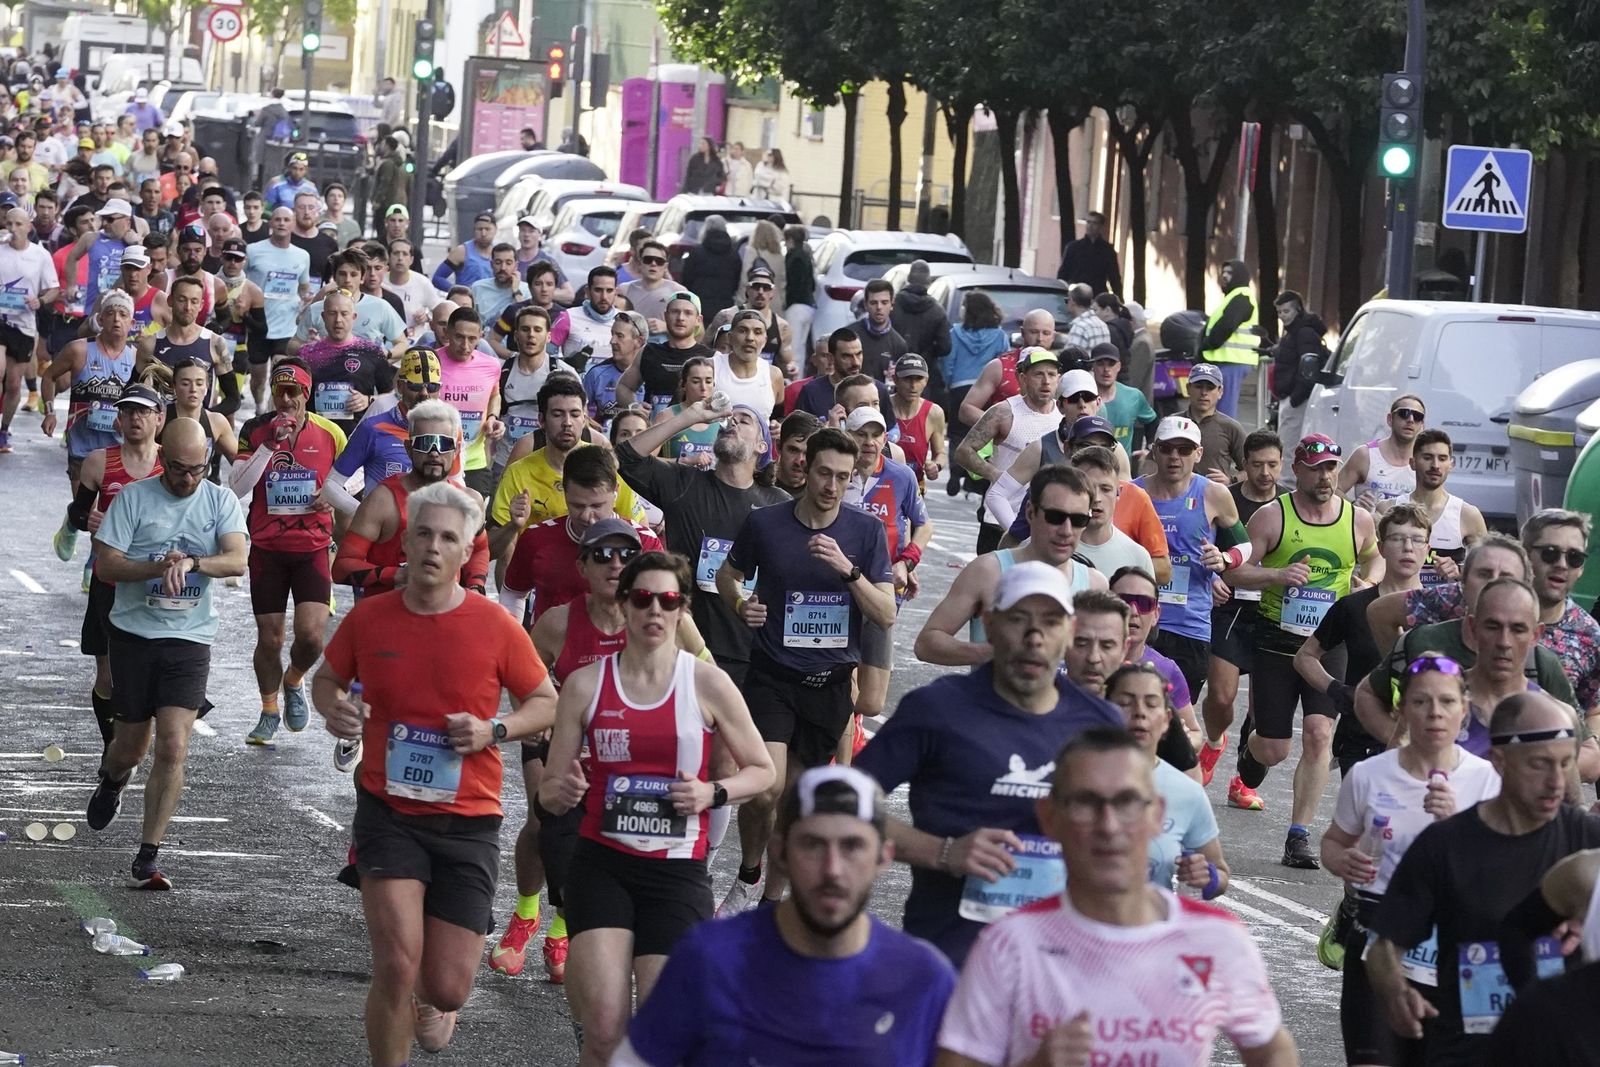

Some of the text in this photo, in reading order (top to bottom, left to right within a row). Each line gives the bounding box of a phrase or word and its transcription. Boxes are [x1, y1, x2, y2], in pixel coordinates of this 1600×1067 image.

[216, 18, 236, 31] 30
[444, 393, 468, 402] RUN
[1486, 458, 1511, 472] MFY
[275, 495, 308, 504] KANIJO
[151, 584, 201, 597] ALRTO
[1302, 591, 1331, 600] ZURICH
[808, 595, 842, 603] ZURICH
[1301, 604, 1317, 613] 8130
[808, 611, 827, 619] 8714
[1296, 612, 1319, 626] IVÁN
[792, 622, 841, 634] QUENTIN
[596, 742, 631, 756] PARK
[410, 752, 434, 764] 5787
[404, 767, 433, 784] EDD
[633, 801, 659, 813] 4966
[617, 815, 672, 834] HONOR
